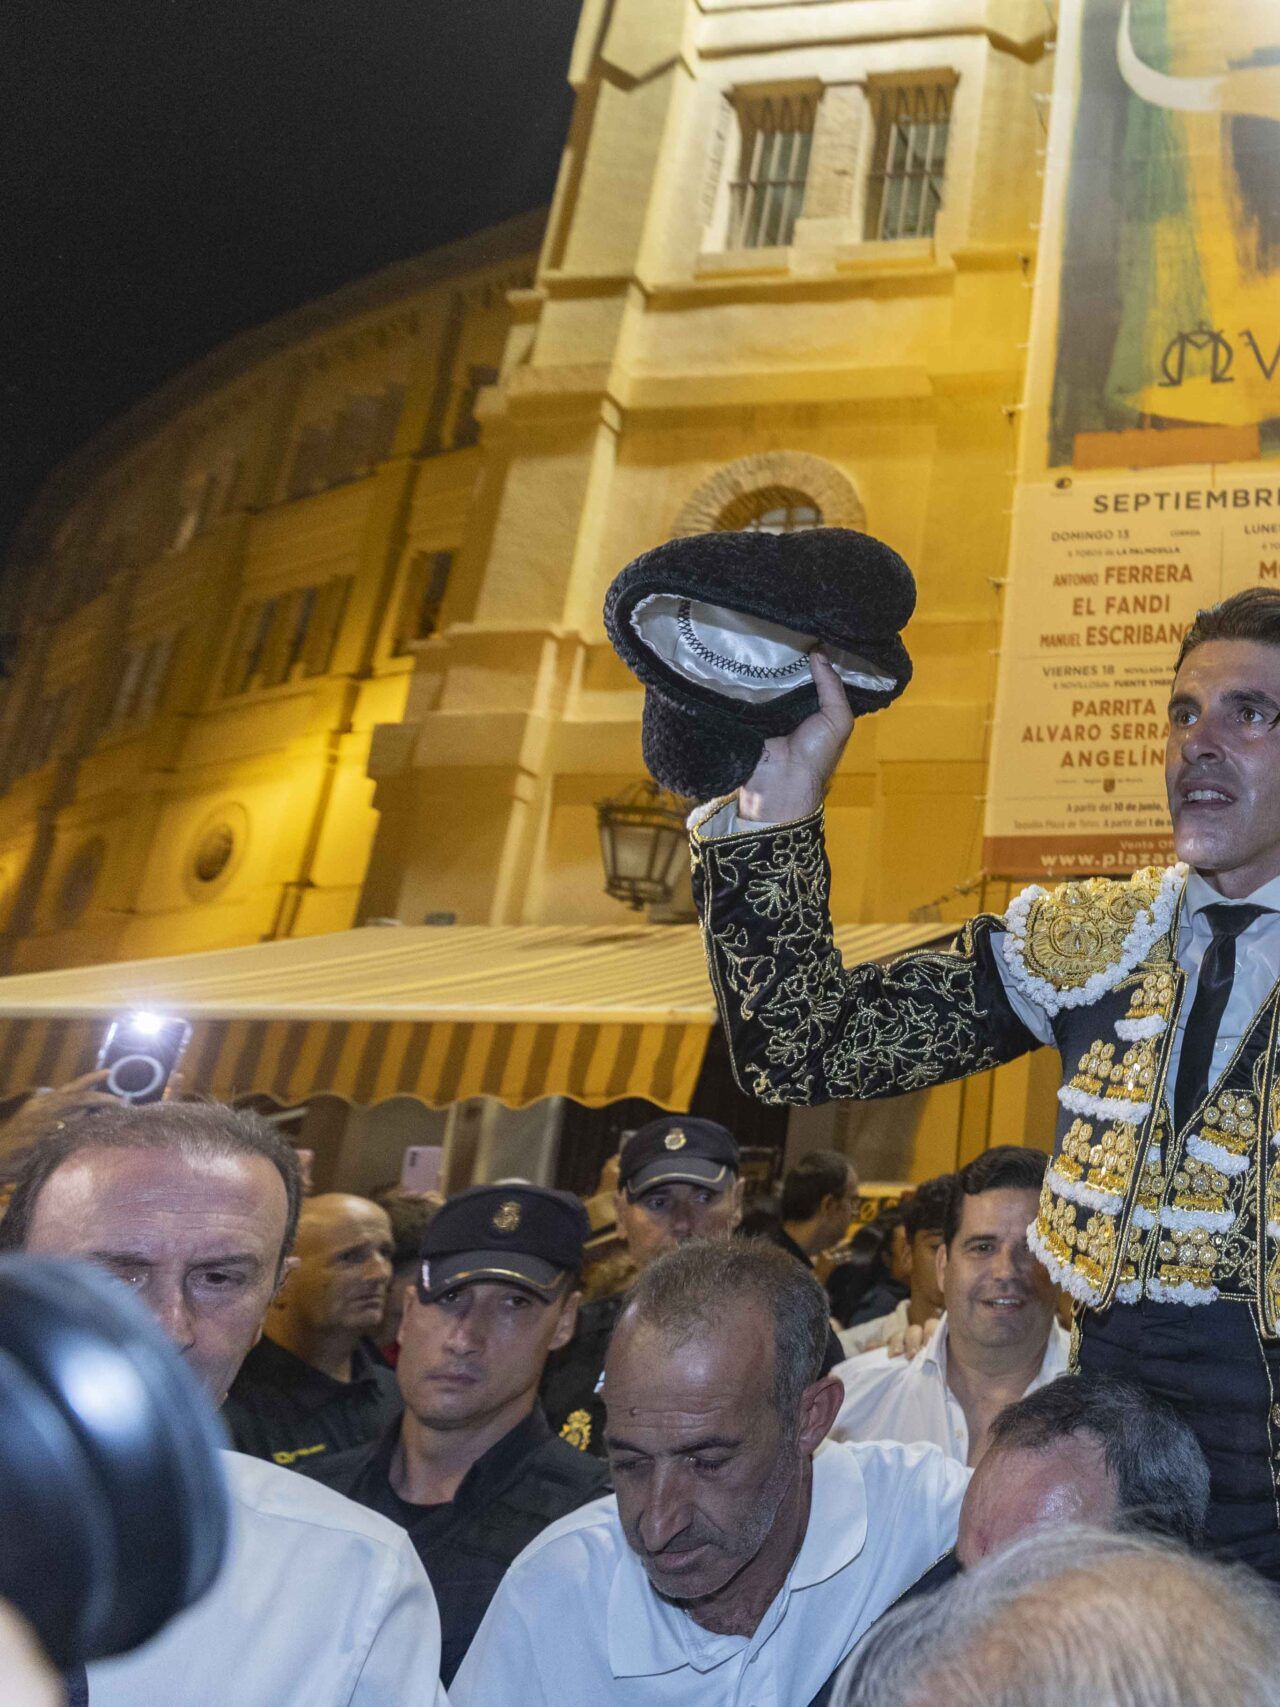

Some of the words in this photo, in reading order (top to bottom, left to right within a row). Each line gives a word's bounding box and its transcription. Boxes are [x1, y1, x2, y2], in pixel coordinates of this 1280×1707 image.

[1051, 530, 1114, 542] DOMINGO
[1053, 572, 1099, 588] ANTONIO
[1104, 563, 1193, 585] FERRERA
[1072, 597, 1096, 617] EL
[1105, 593, 1171, 616] FANDI
[1042, 664, 1098, 678] VIERNES
[1102, 664, 1115, 676] 18
[1072, 697, 1157, 718] PARRITA
[1021, 723, 1102, 744] ALVARO
[1110, 721, 1169, 741] SERRA
